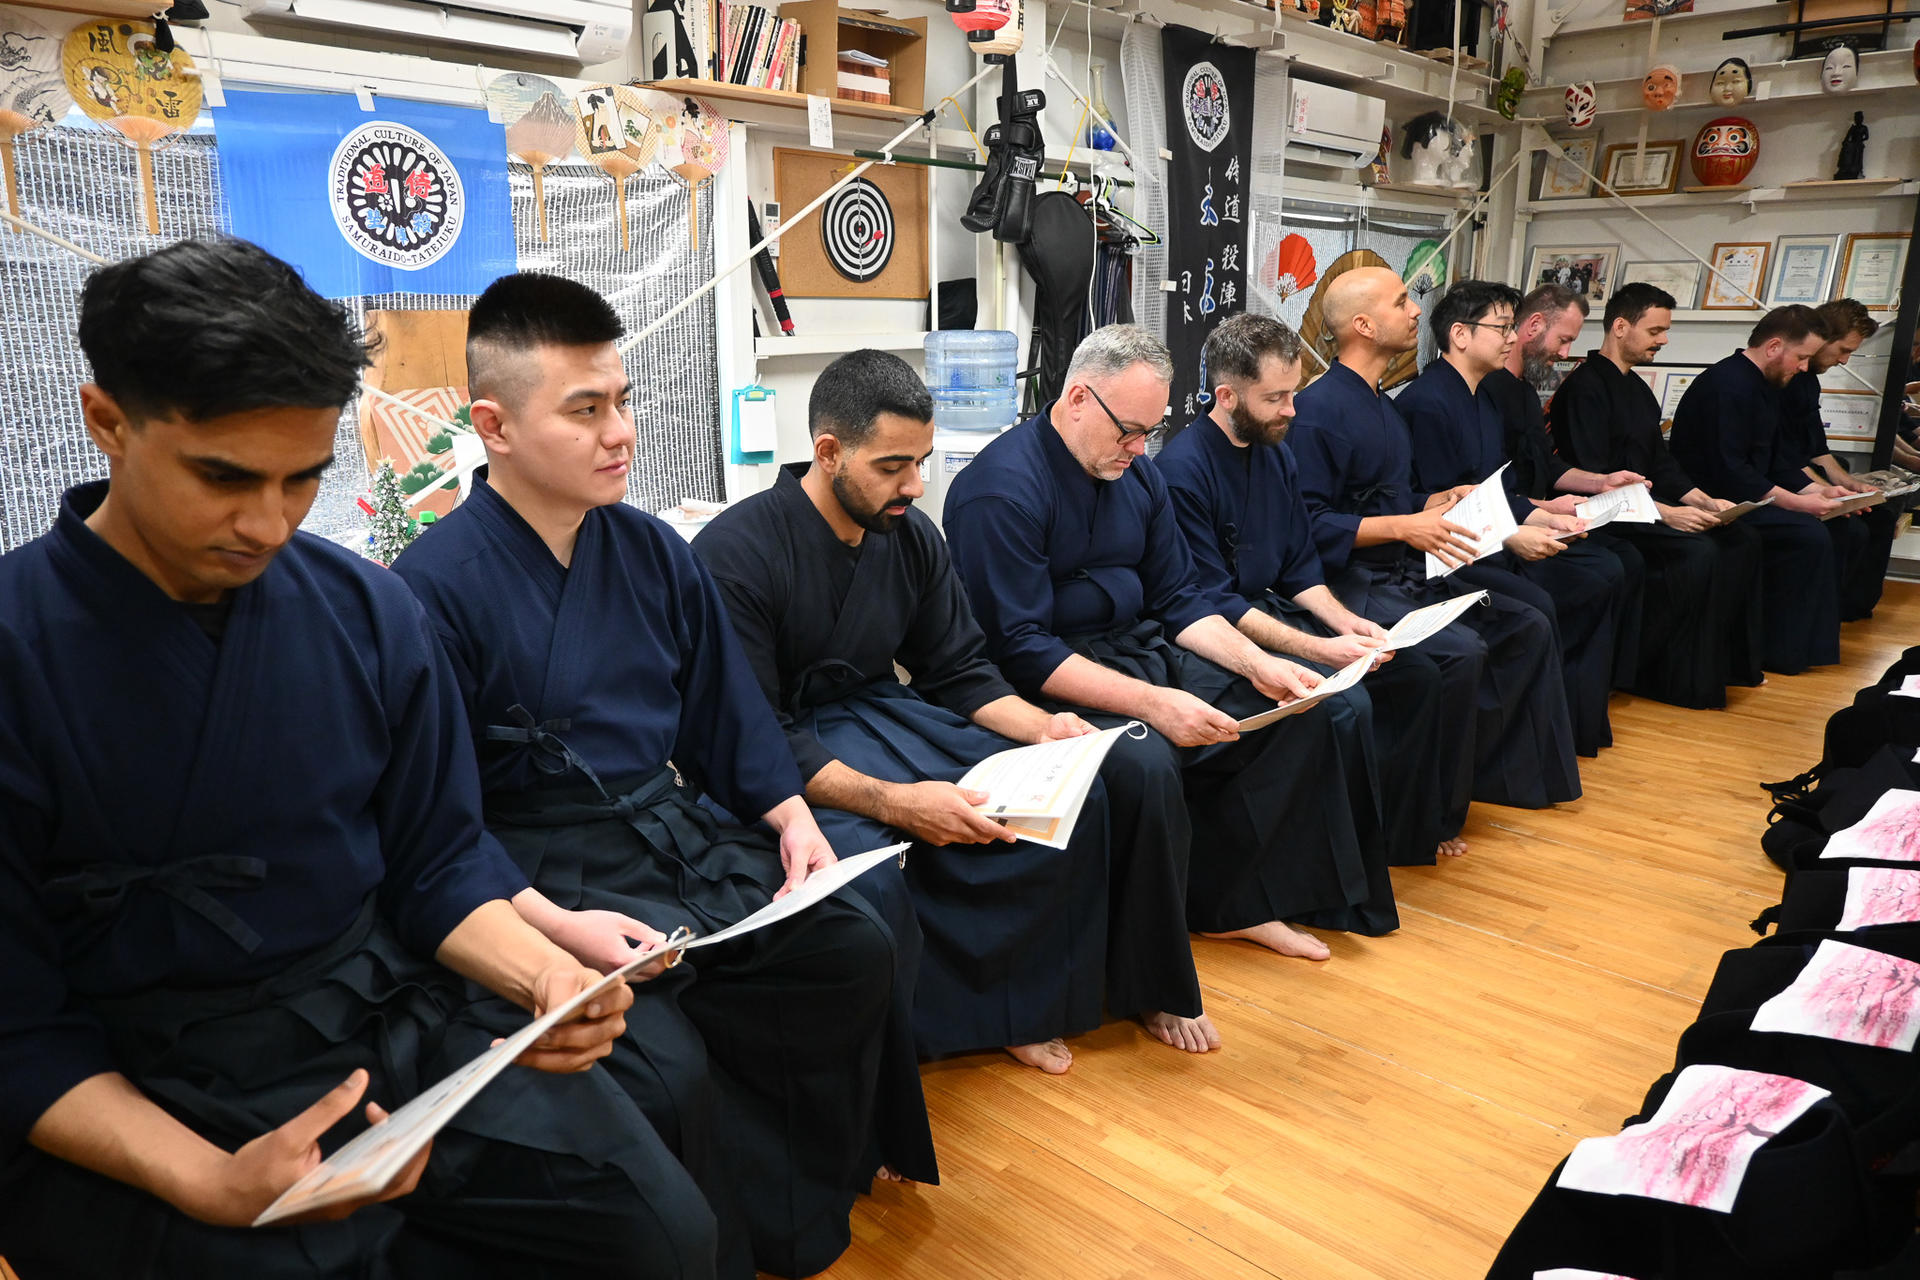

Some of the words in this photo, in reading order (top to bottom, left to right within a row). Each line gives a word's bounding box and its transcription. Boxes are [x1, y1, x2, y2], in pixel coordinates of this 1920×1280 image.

[88, 25, 121, 55] 風
[155, 90, 183, 118] 雷
[337, 134, 371, 203] TRADITIONAL
[374, 129, 426, 152] CULTURE
[428, 152, 442, 166] OF
[441, 169, 458, 205] JAPAN
